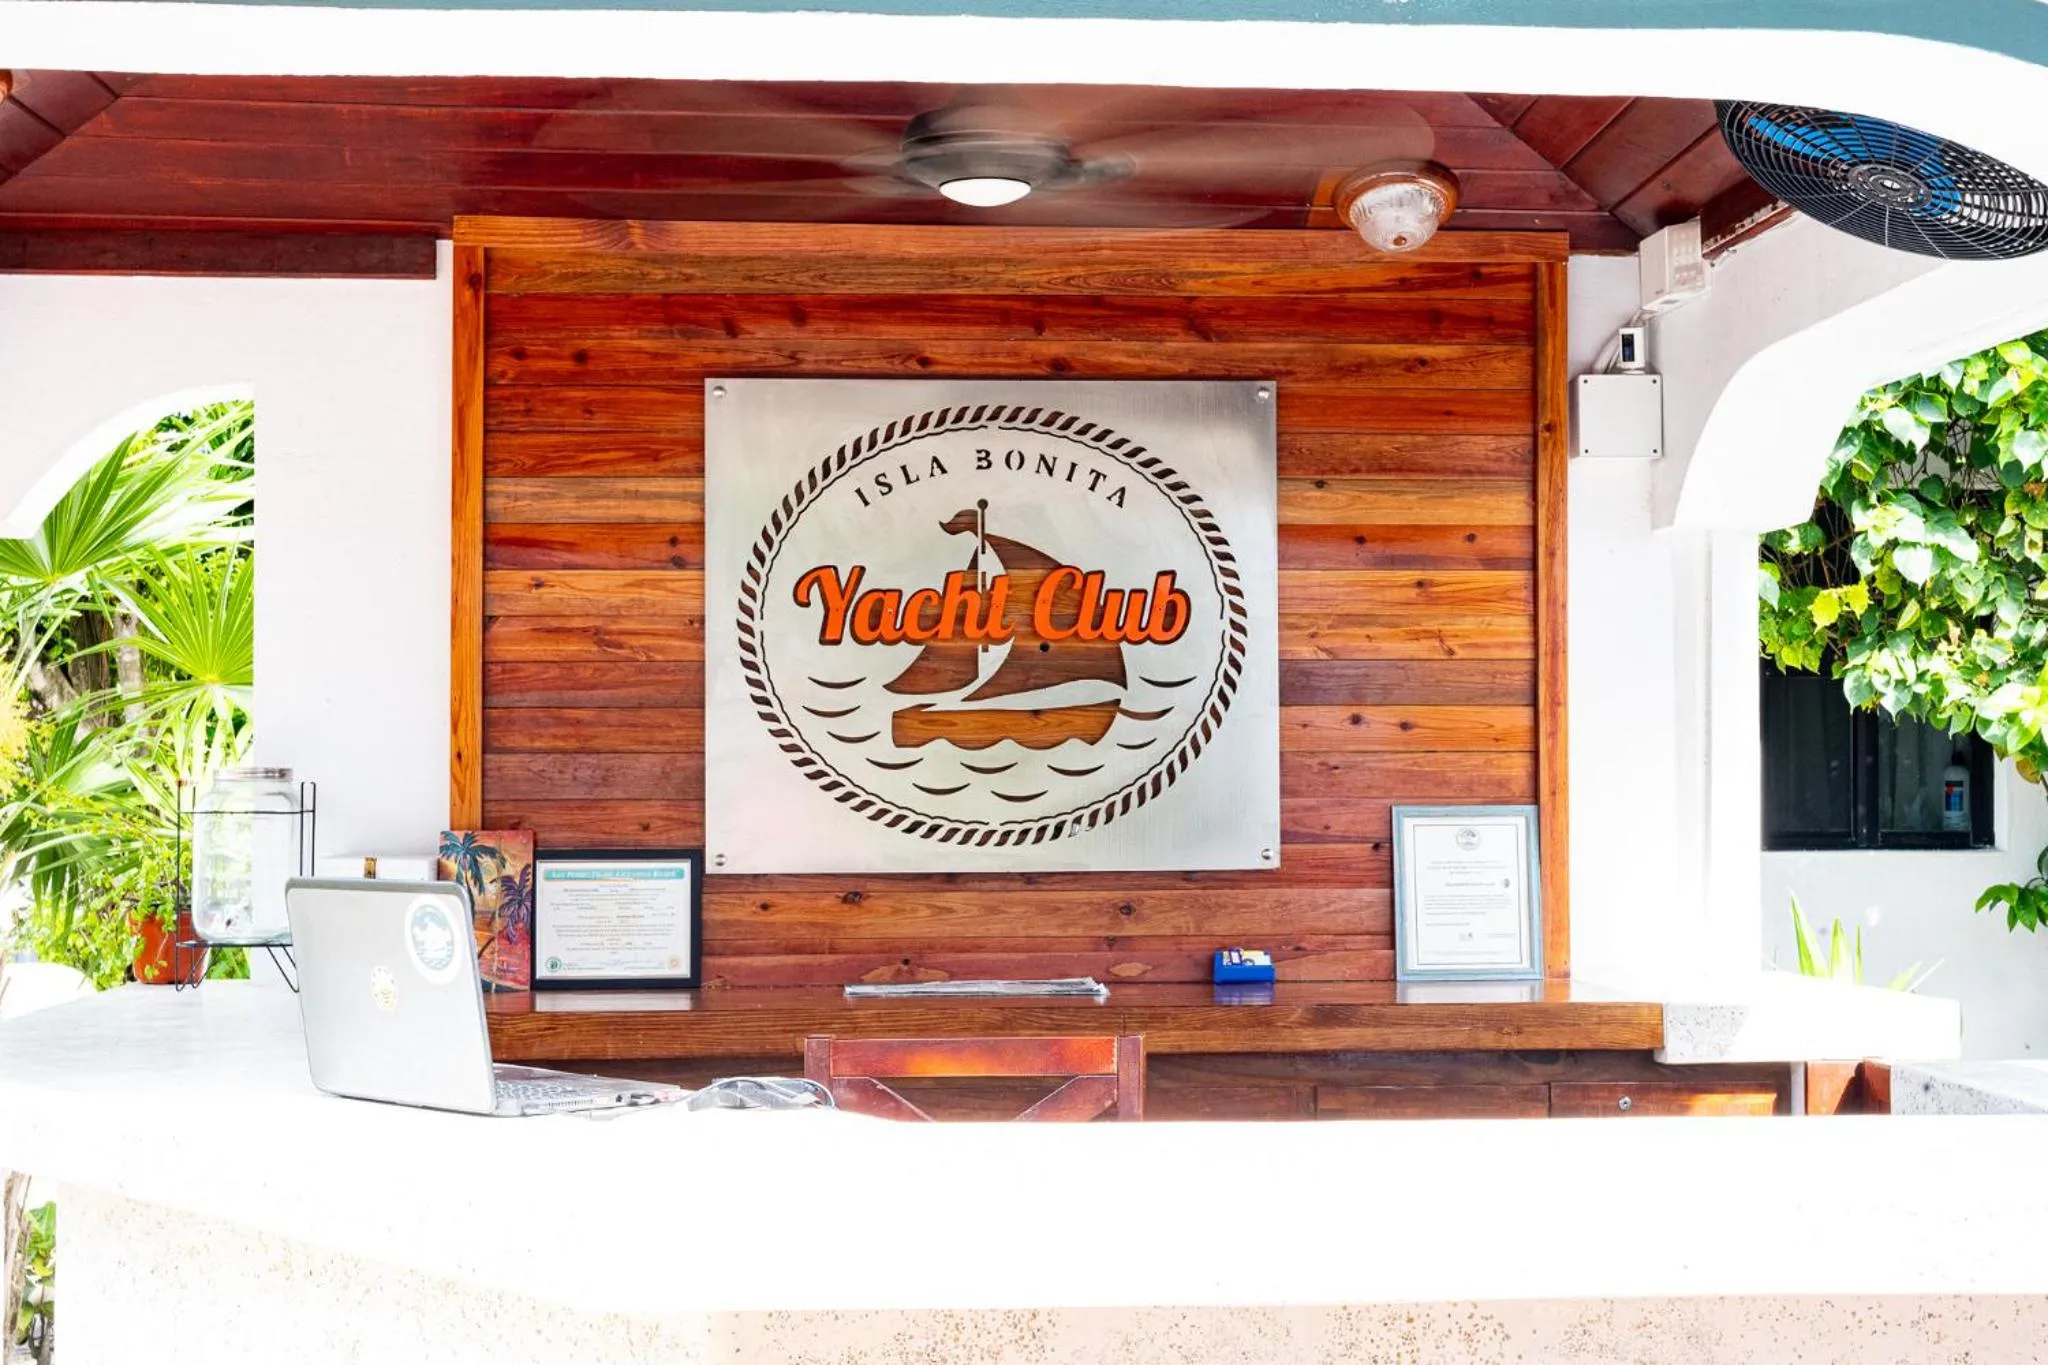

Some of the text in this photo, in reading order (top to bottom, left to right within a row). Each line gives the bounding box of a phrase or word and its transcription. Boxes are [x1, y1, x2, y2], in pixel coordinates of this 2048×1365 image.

[854, 448, 1127, 508] ISLA BONITA
[793, 564, 1192, 646] Yacht Club
